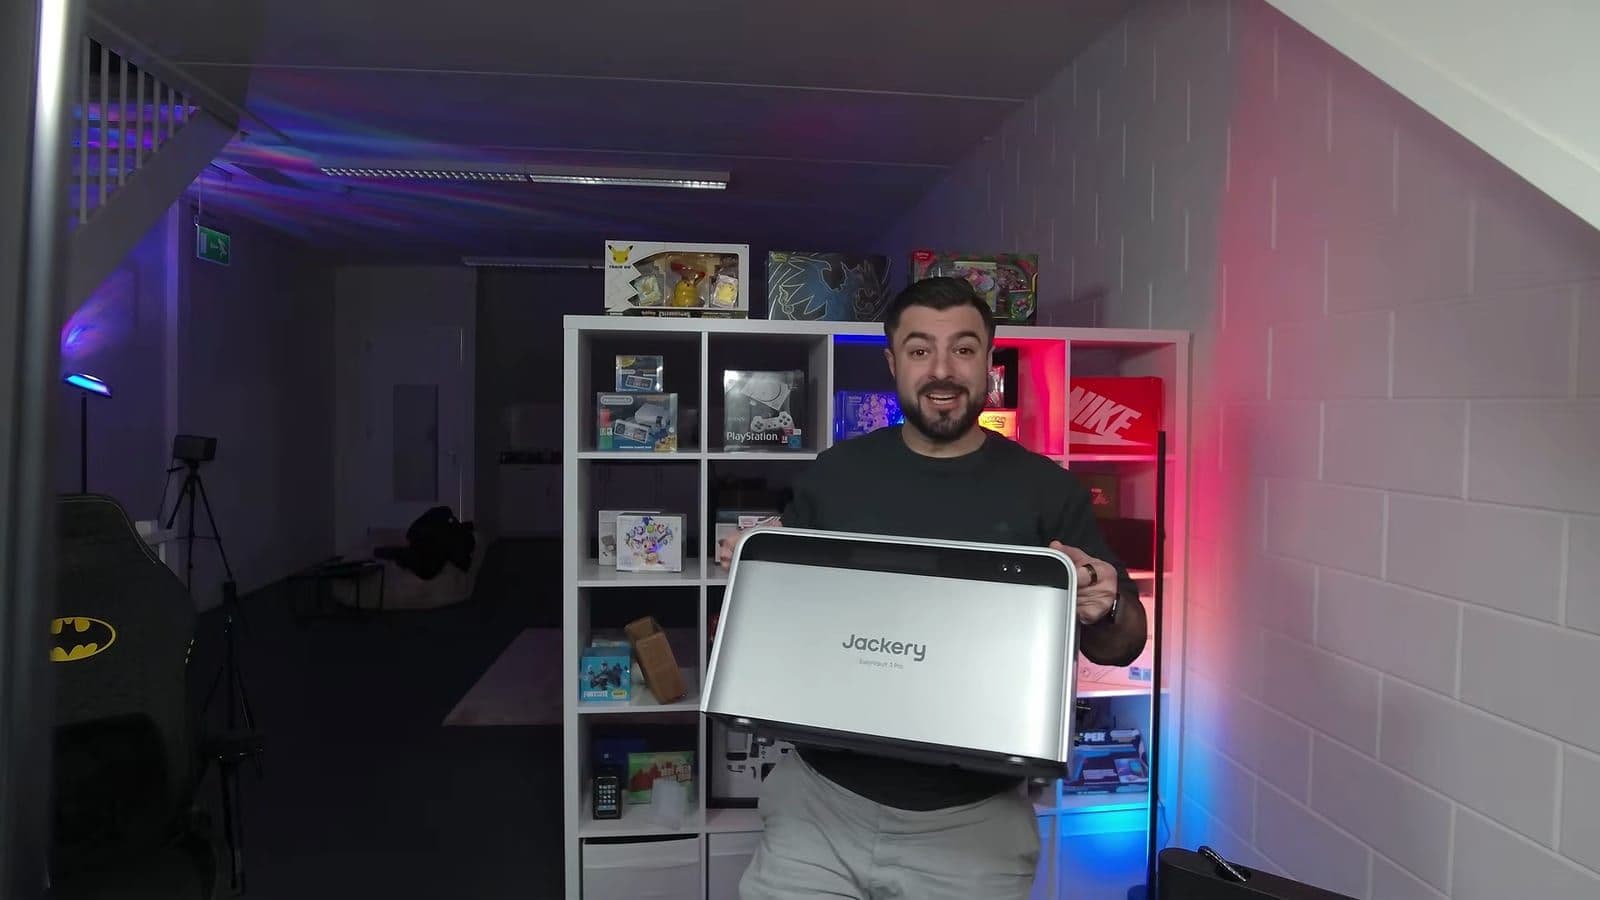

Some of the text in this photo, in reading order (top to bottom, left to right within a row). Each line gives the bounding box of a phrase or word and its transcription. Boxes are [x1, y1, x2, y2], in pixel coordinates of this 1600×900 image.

[1070, 386, 1142, 439] NIKE
[726, 431, 778, 442] PlayStation
[842, 634, 926, 662] Jackery
